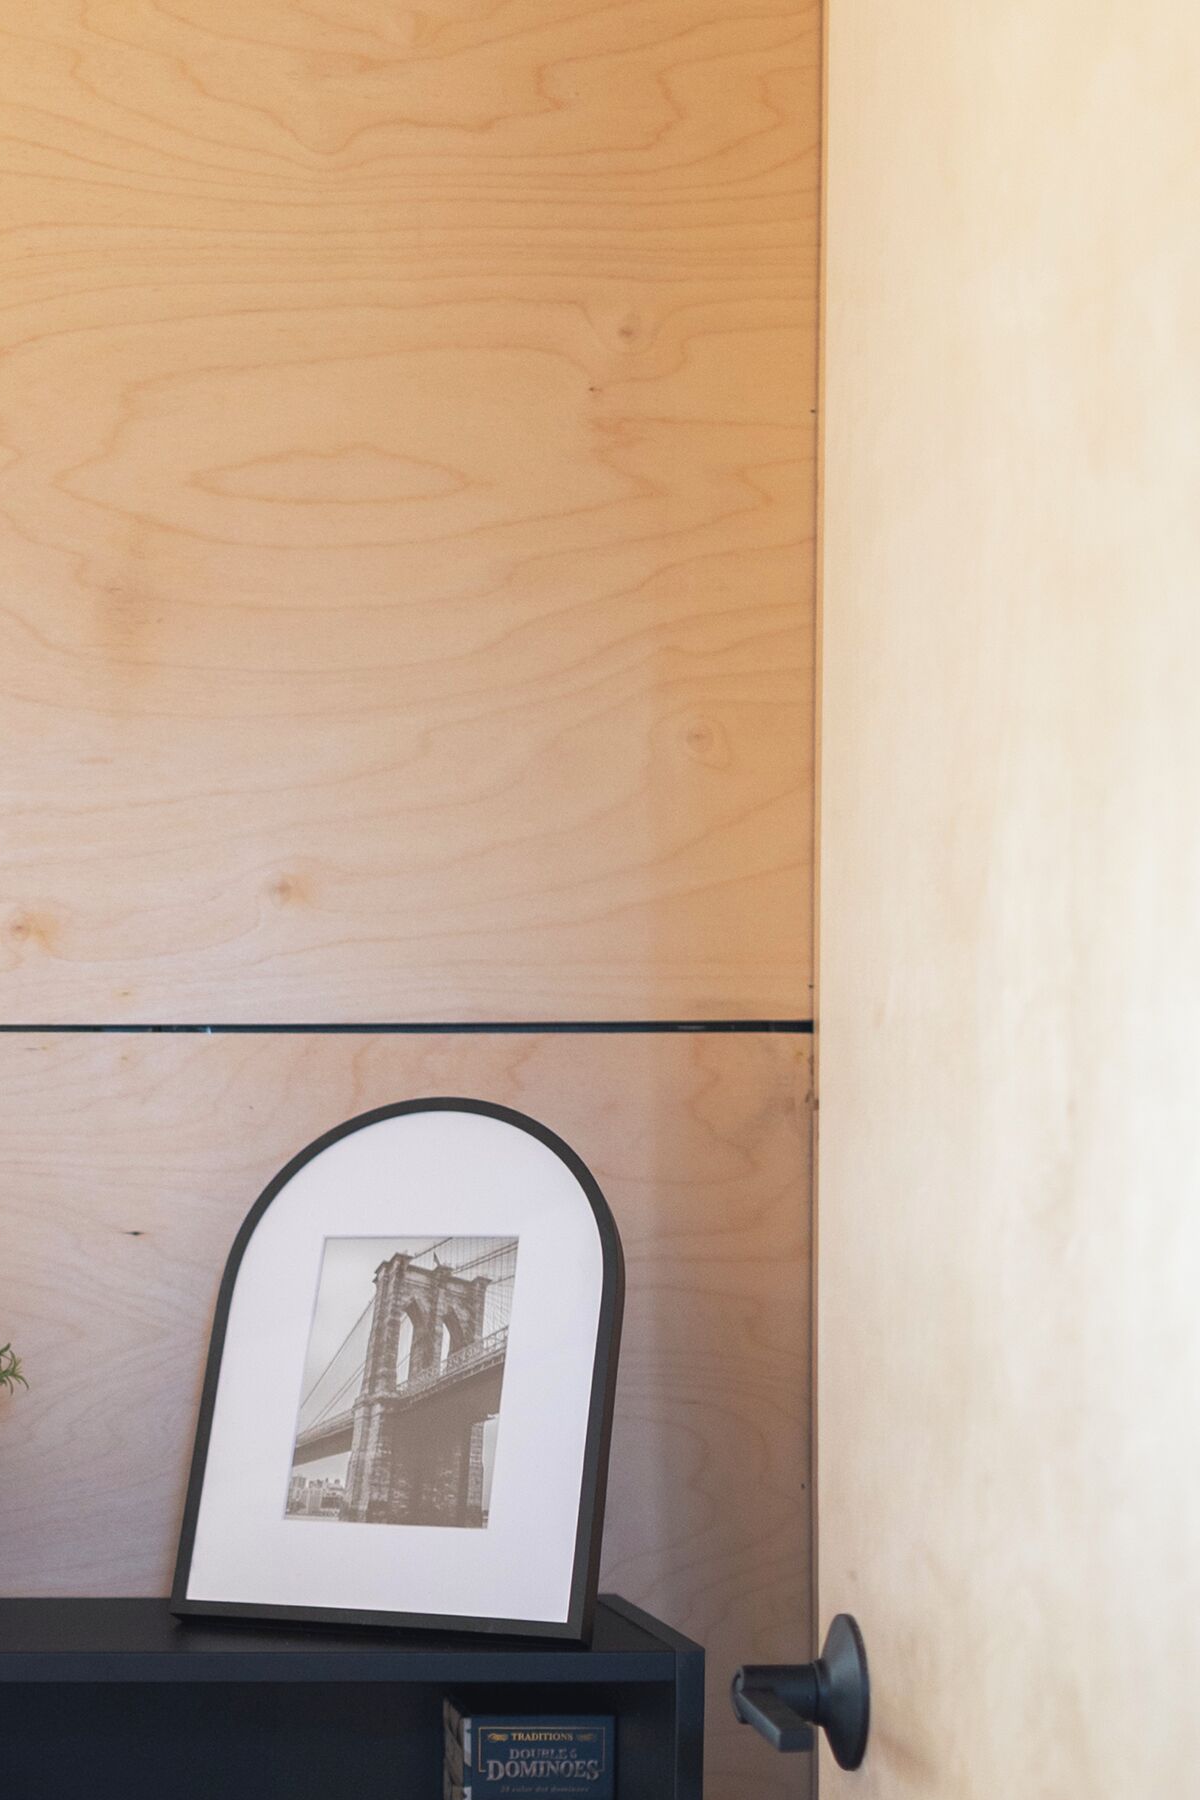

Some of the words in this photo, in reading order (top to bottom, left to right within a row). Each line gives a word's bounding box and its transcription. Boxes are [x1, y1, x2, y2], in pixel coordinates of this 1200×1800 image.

[511, 1733, 574, 1742] TRADITIONS
[509, 1748, 568, 1760] DOUBLE
[486, 1760, 600, 1781] DOMINOES
